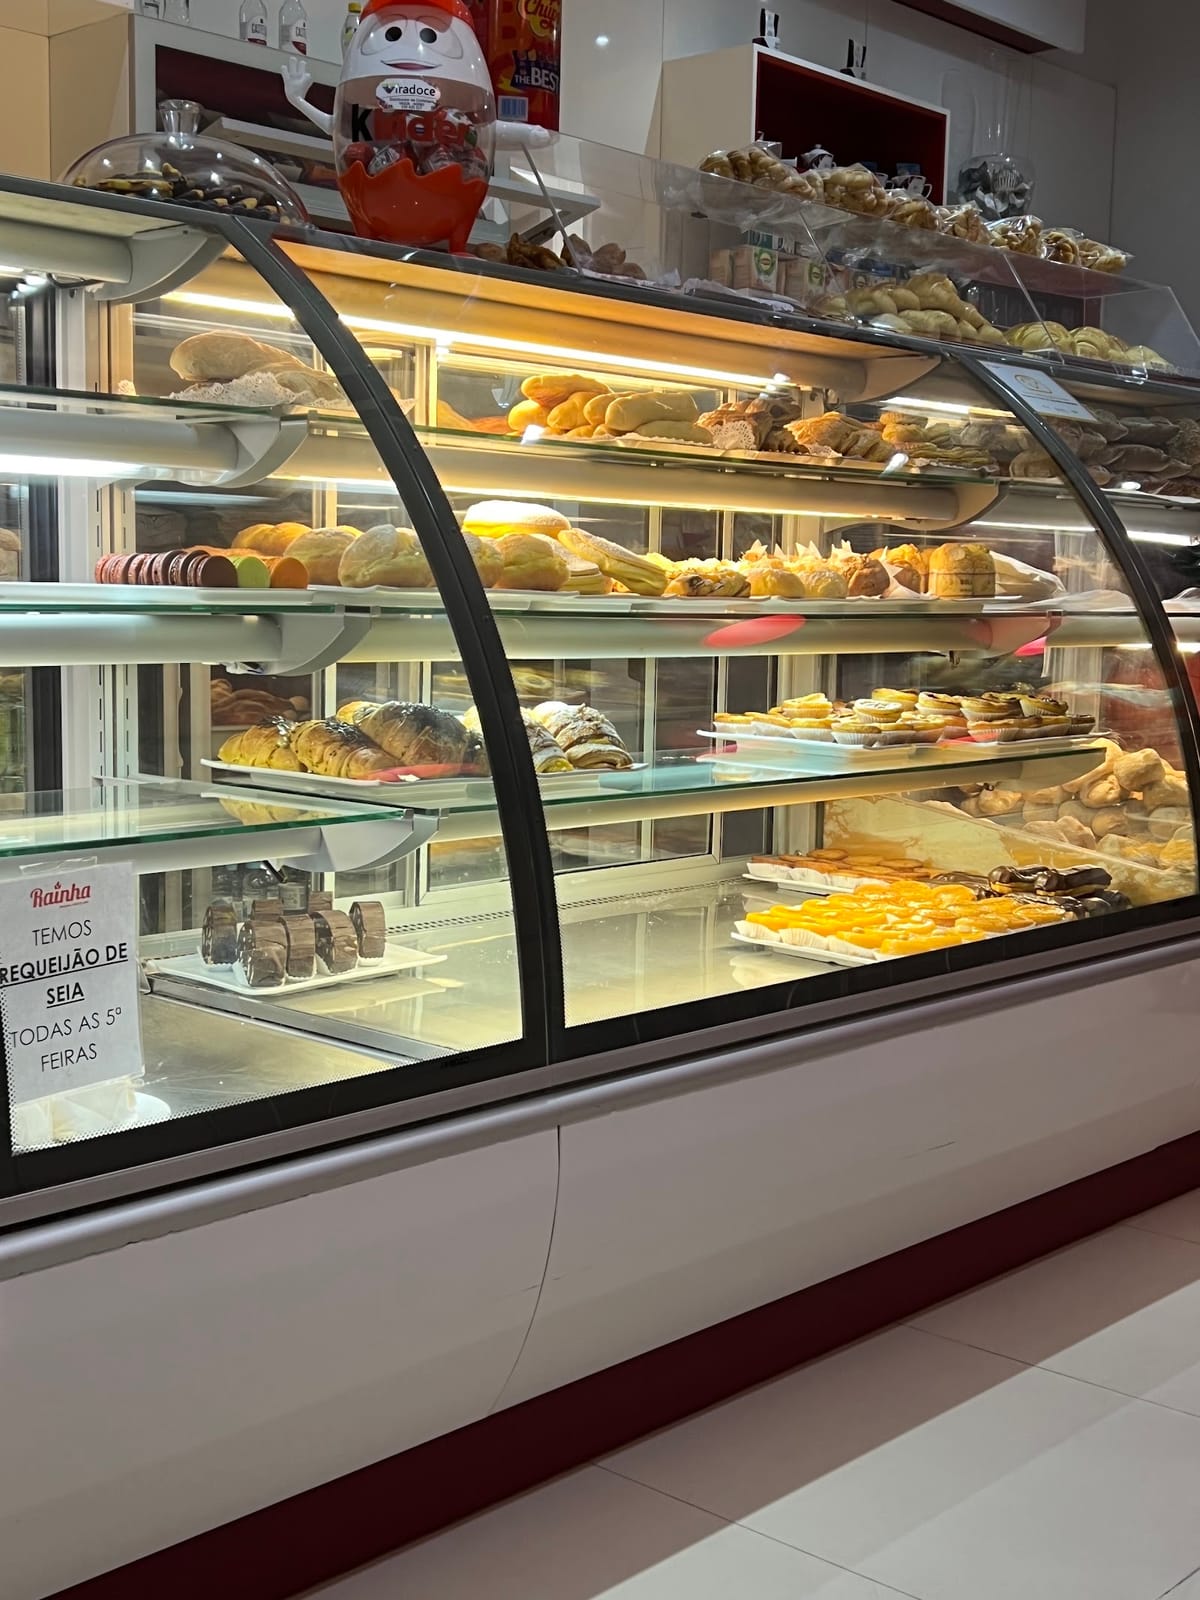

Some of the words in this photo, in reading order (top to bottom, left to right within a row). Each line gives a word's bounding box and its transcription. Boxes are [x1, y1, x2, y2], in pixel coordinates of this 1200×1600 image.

[382, 83, 436, 97] Viradoce
[515, 74, 531, 84] THE
[30, 883, 91, 909] Rainha
[32, 920, 92, 946] TEMOS
[0, 947, 99, 985] REQUEIJÃO
[106, 942, 128, 960] DE
[47, 982, 84, 1005] SEIA
[10, 1018, 72, 1048] TODAS
[79, 1012, 100, 1033] AS
[41, 1043, 97, 1072] FEIRAS
